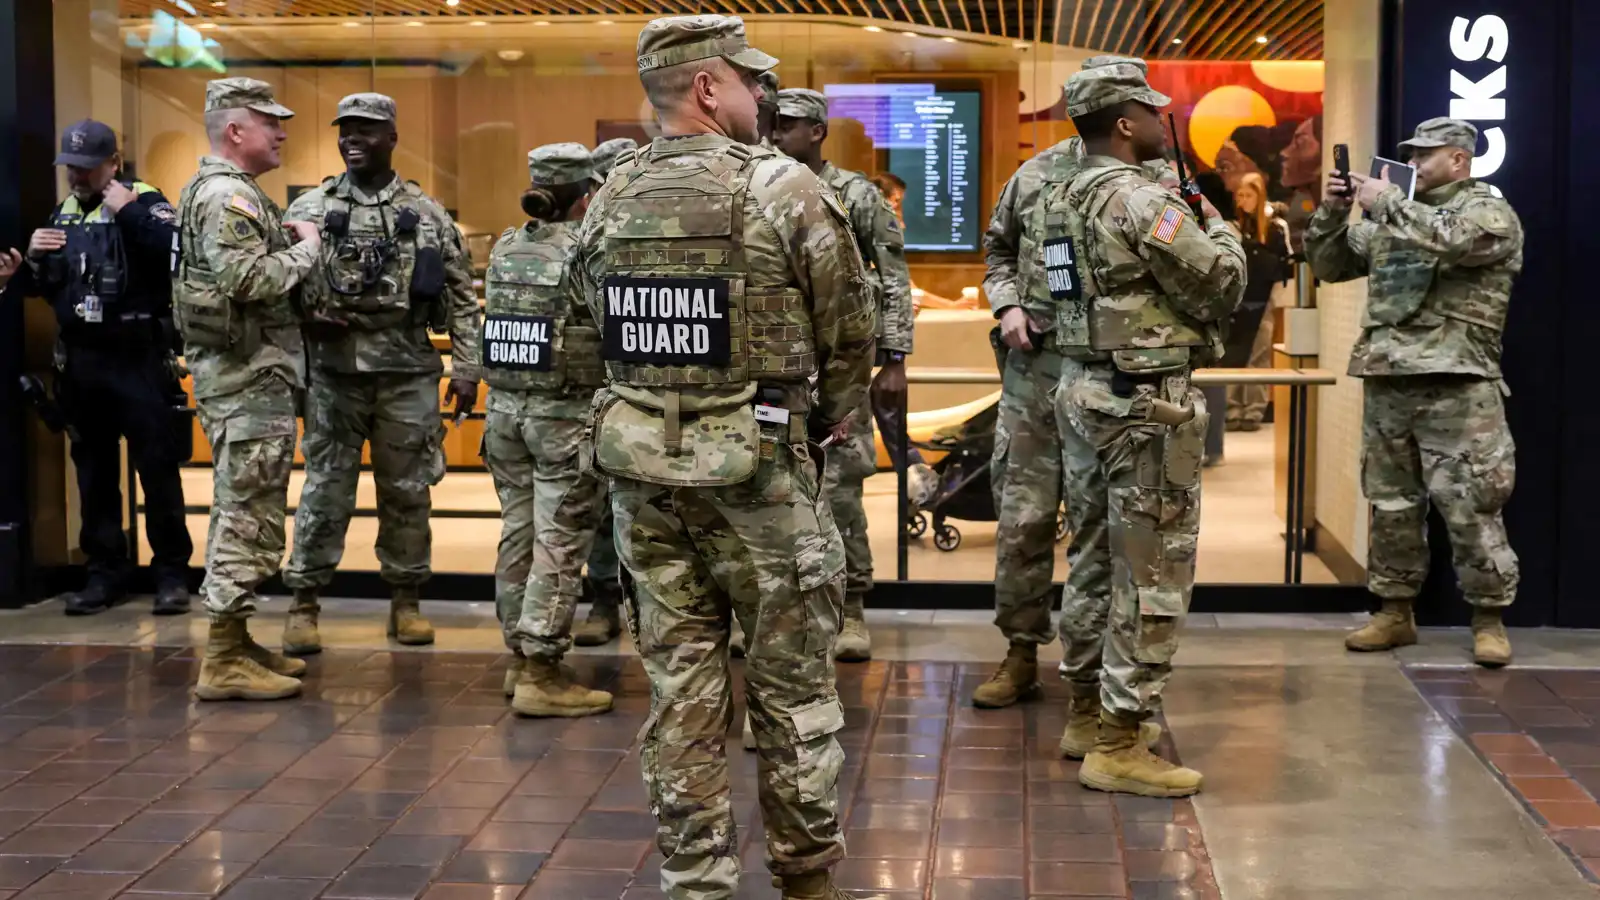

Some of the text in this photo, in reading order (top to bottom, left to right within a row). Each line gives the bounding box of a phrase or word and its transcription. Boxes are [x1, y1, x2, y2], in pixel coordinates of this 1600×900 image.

[1449, 14, 1509, 198] CKS
[1047, 268, 1073, 292] GUARD
[607, 286, 723, 319] NATIONAL
[484, 319, 549, 343] NATIONAL
[621, 321, 710, 354] GUARD
[489, 341, 540, 365] GUARD
